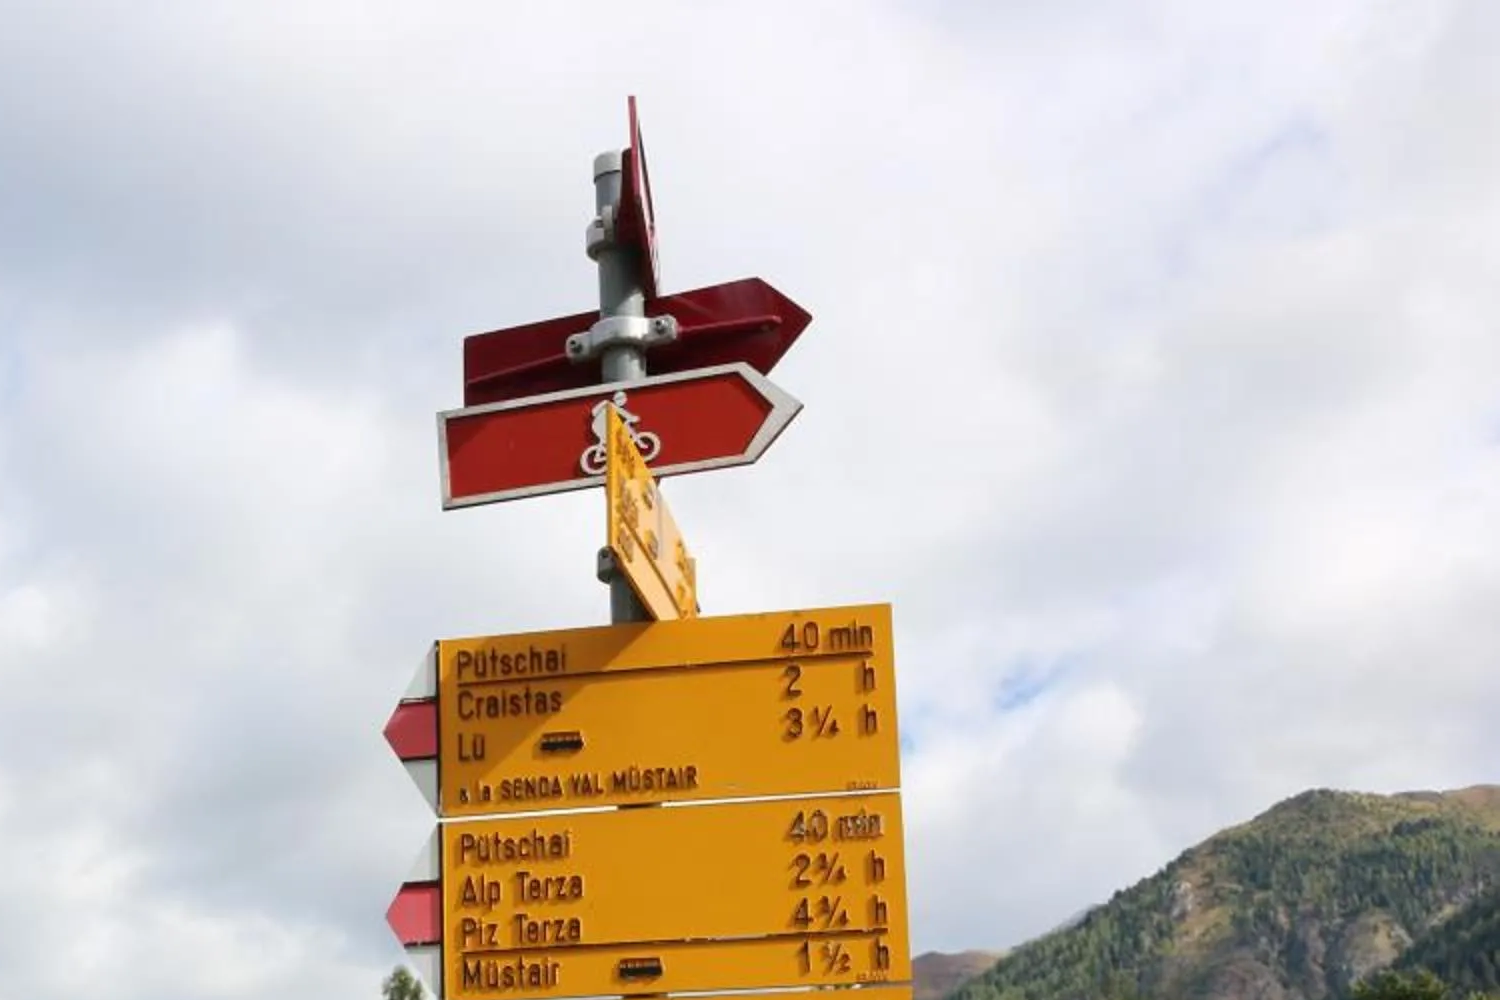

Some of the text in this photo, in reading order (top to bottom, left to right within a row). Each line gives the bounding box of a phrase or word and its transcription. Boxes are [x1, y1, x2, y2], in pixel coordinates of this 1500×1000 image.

[456, 619, 873, 679] Pütschai 40 min
[457, 660, 876, 721] Craistas 2 h
[458, 732, 486, 762] Lü
[862, 704, 877, 735] h
[500, 775, 563, 801] SENDA
[570, 770, 603, 796] VAL
[612, 763, 698, 793] MÜSTAIR
[460, 828, 571, 864] Pütschai
[788, 809, 828, 841] 40
[461, 873, 501, 911] Alp
[515, 870, 584, 903] Terza
[868, 848, 885, 881] h
[461, 916, 499, 948] Piz
[513, 912, 582, 944] Terza
[871, 894, 888, 925] h
[461, 955, 560, 992] Müstair
[873, 936, 890, 971] h
